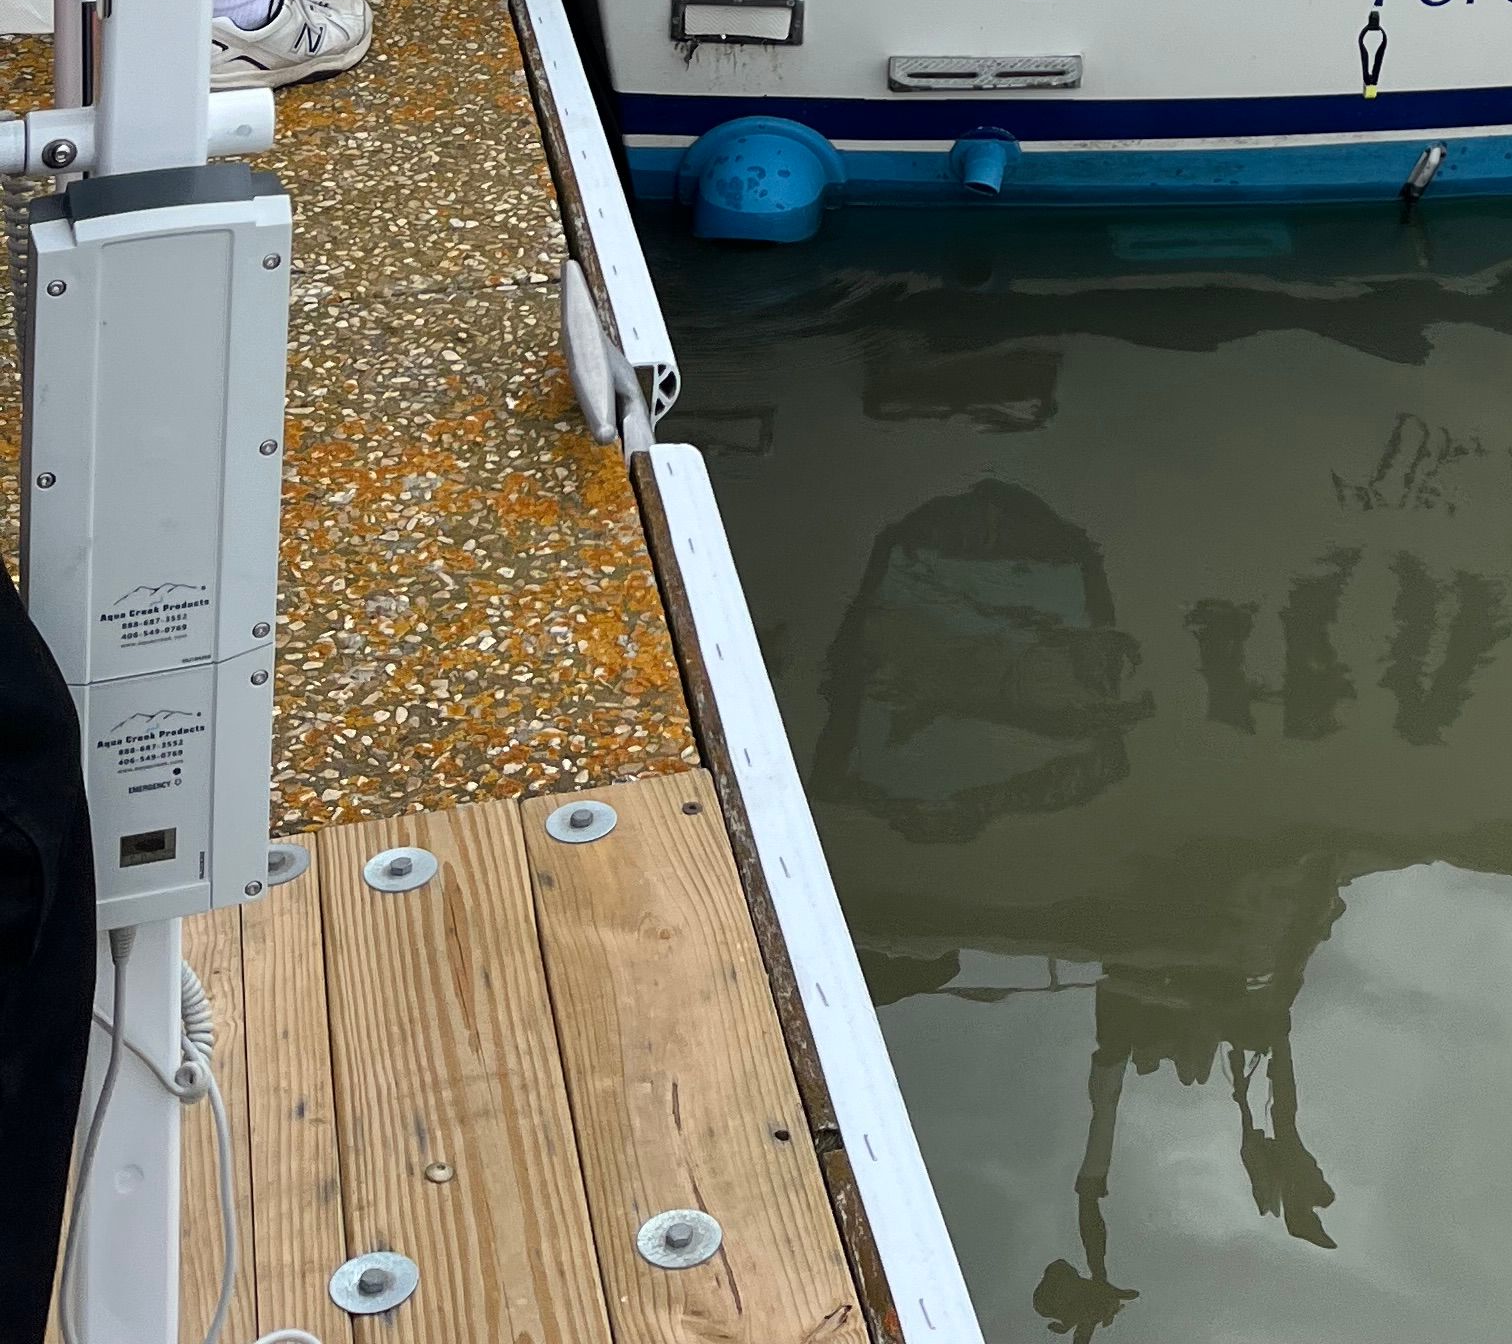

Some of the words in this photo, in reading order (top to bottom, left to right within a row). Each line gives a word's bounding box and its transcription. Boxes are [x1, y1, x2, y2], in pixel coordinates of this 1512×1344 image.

[99, 612, 126, 622] Aqua
[129, 606, 160, 618] Creek
[162, 598, 210, 612] Products
[96, 739, 123, 749] Aqua
[125, 732, 156, 743] Creek
[158, 724, 206, 738] Products
[128, 780, 171, 795] EMERGENCY
